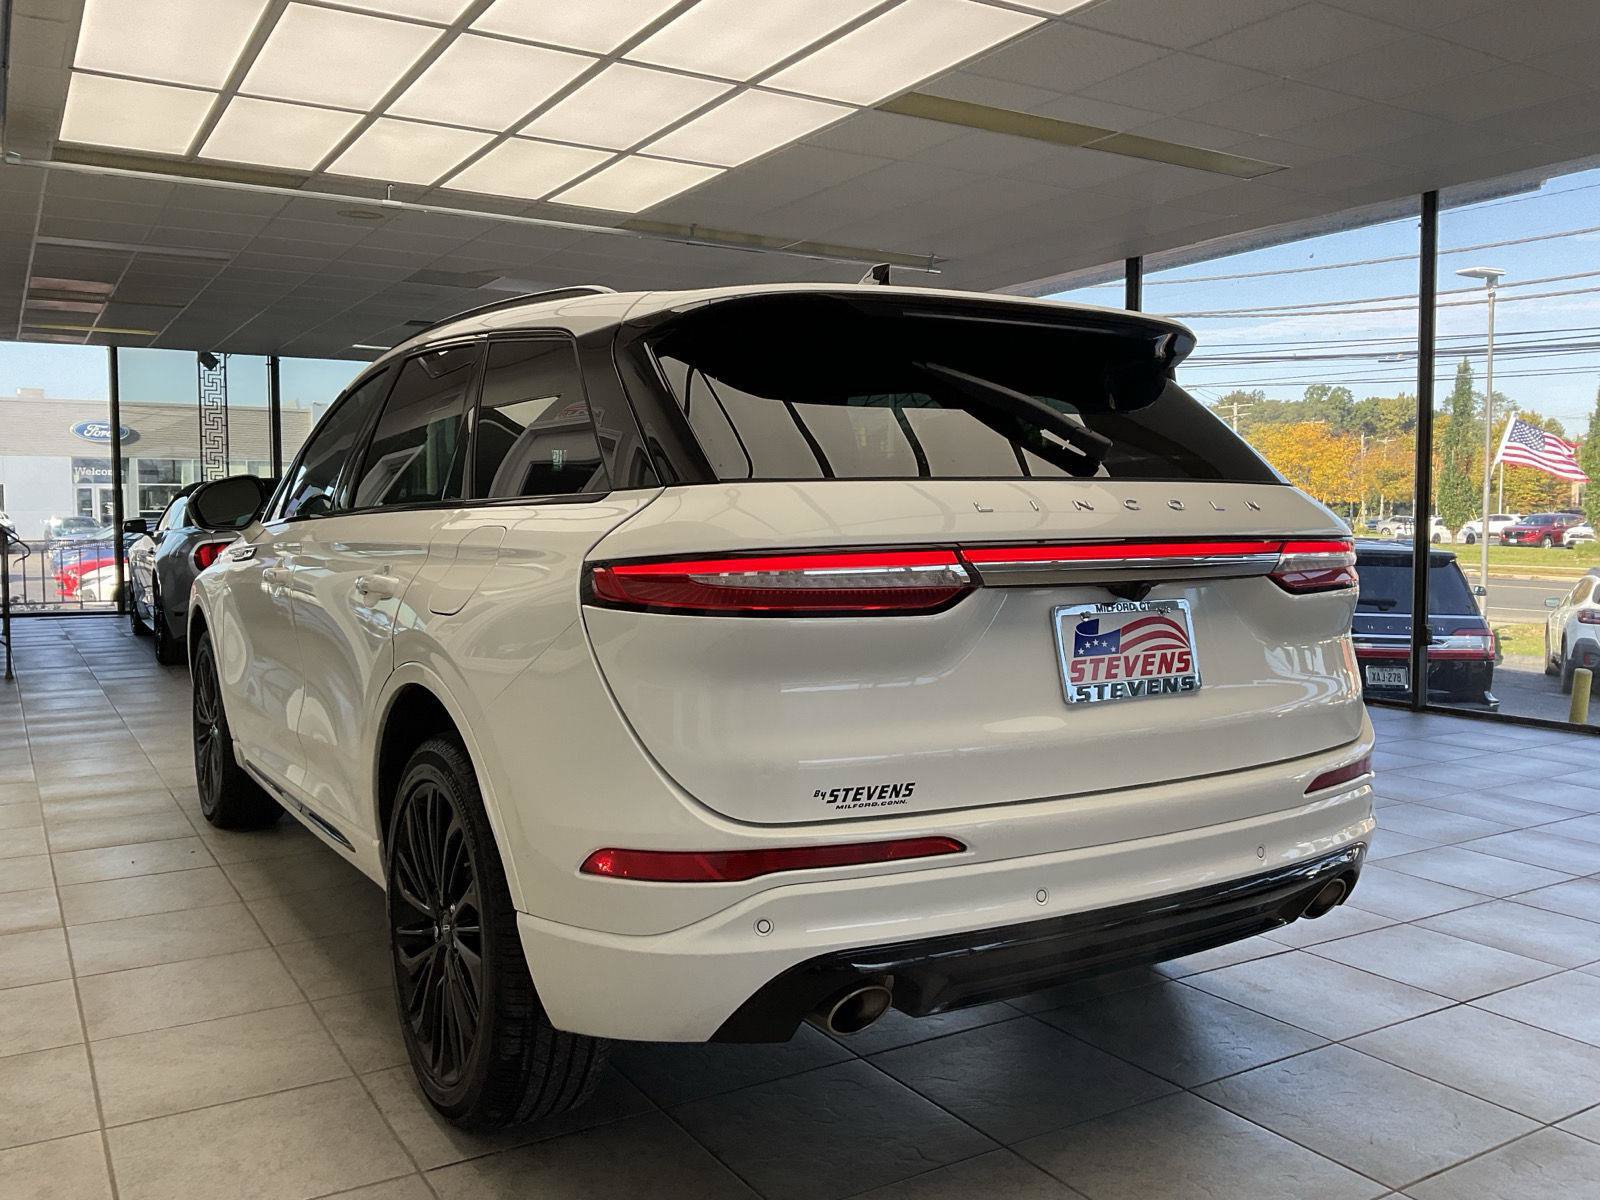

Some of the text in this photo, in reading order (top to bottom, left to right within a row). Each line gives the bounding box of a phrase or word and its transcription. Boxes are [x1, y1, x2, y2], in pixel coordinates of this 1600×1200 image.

[974, 499, 1261, 512] LINCOLN
[1070, 650, 1191, 683] STEVENS
[1075, 675, 1196, 702] STEVENS
[813, 782, 915, 804] By STEVENS
